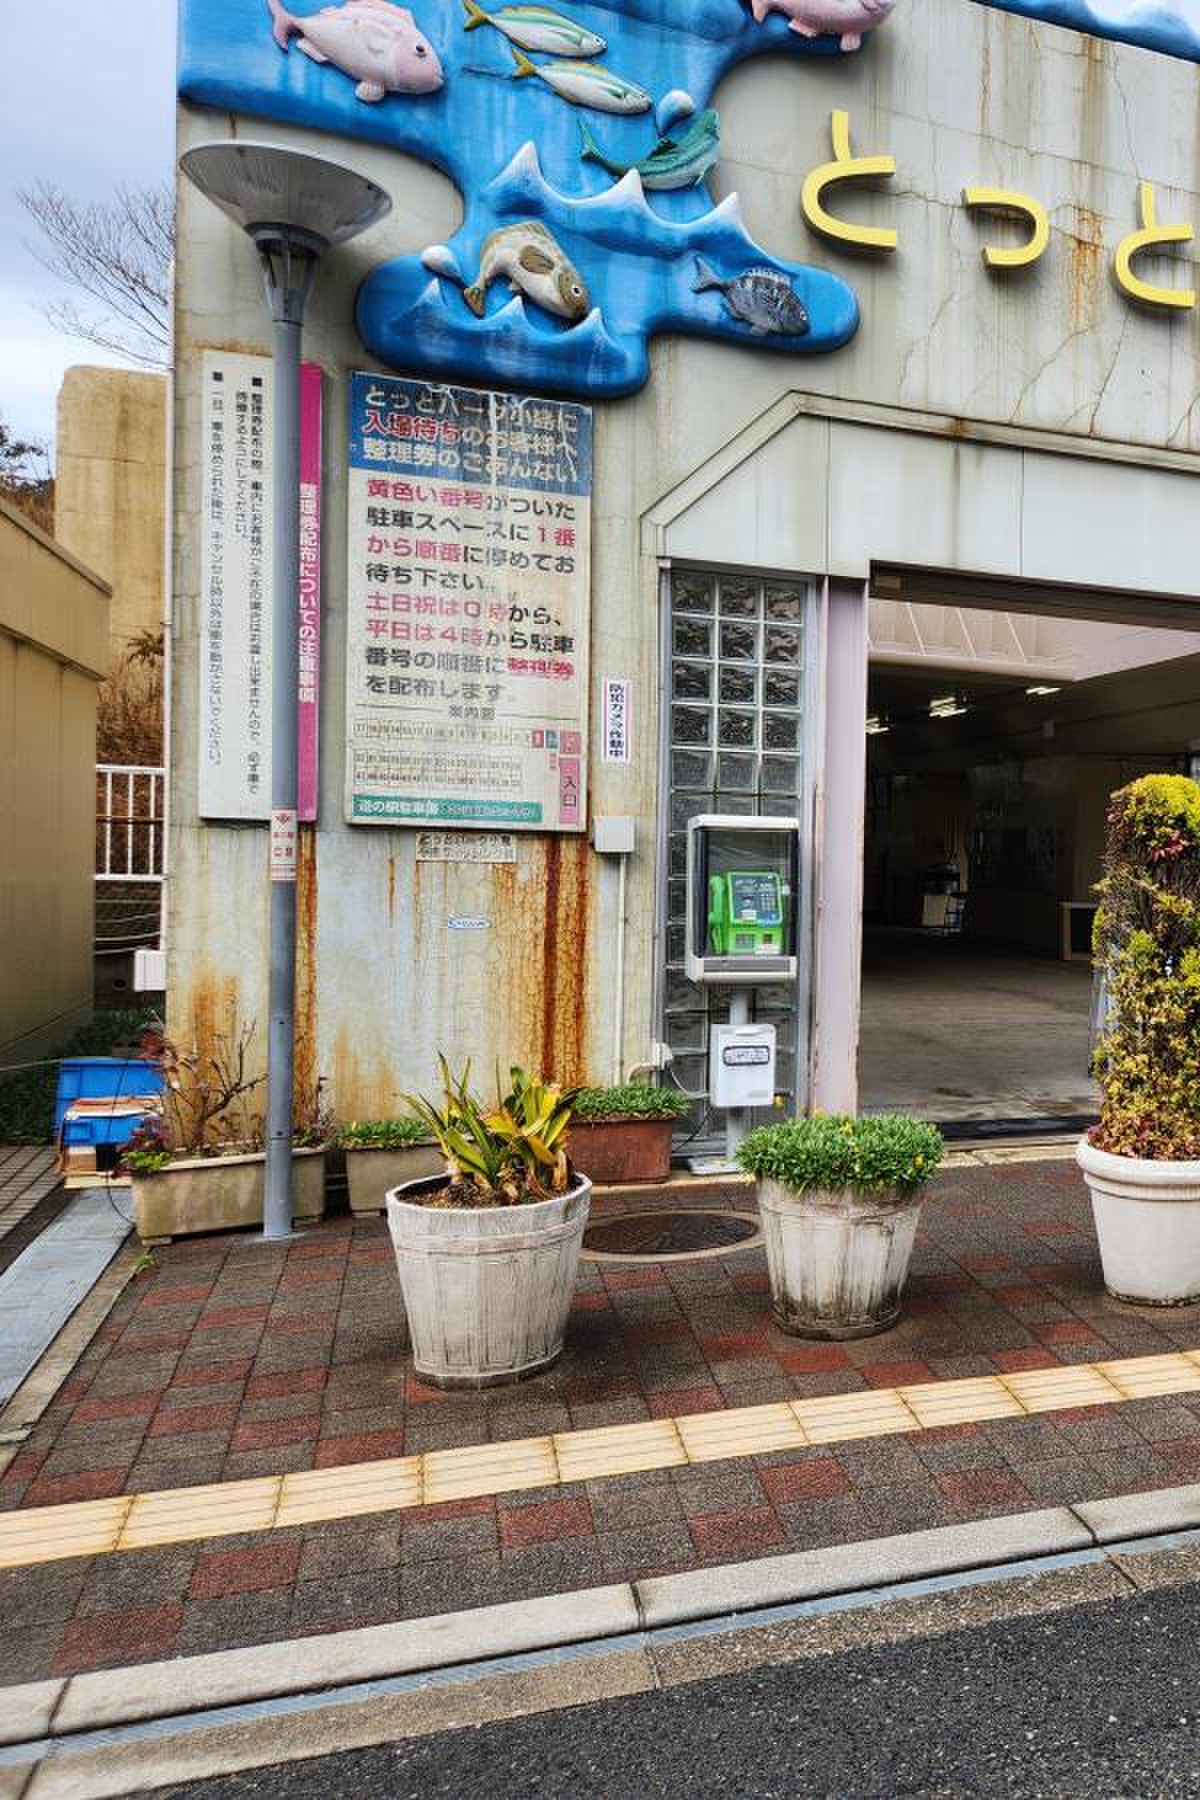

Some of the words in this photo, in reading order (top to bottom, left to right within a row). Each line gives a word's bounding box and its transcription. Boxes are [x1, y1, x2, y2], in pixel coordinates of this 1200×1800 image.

[367, 479, 576, 522] 黄色い番号がついた
